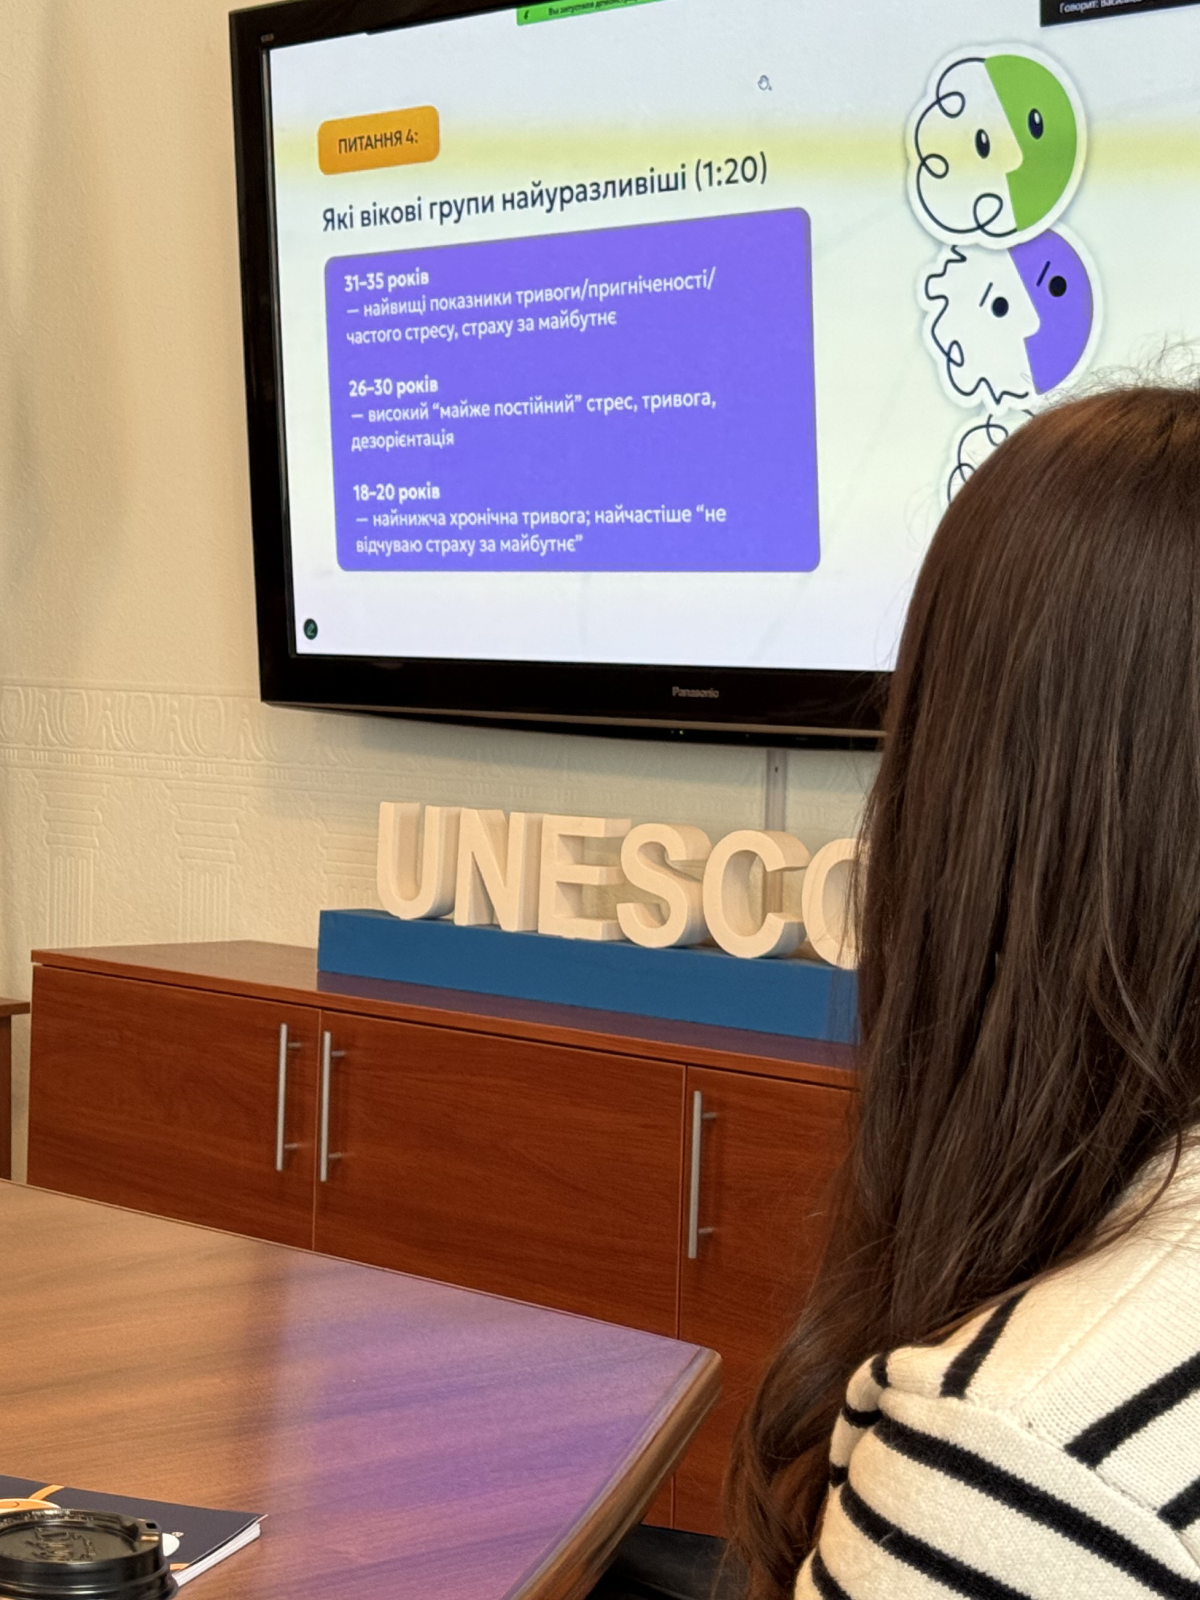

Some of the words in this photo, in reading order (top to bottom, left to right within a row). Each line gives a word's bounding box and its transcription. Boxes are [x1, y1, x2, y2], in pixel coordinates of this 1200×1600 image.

[338, 130, 403, 154] ПИТАННЯ
[405, 128, 419, 145] 4:
[322, 204, 354, 232] Які
[360, 196, 423, 227] вікові
[429, 194, 495, 226] групи
[502, 163, 686, 213] найуразливіші
[695, 151, 767, 192] (1:20)
[363, 295, 426, 317] найвищі
[430, 291, 512, 312] показники
[515, 266, 716, 308] тривоги/пригніченості/
[388, 267, 430, 293] років
[346, 328, 402, 345] частого
[405, 323, 459, 344] стресу,
[462, 319, 514, 340] страху
[517, 317, 534, 332] за
[539, 308, 618, 332] майбутнє
[396, 374, 439, 399] років
[368, 402, 429, 422] високий
[586, 396, 638, 416] стрес,
[642, 391, 717, 414] тривога,
[351, 428, 455, 452] дезорієнтація
[398, 481, 441, 504] років
[372, 508, 446, 527] найнижча
[450, 507, 518, 530] хронічна
[522, 509, 591, 529] тривога;
[595, 504, 692, 524] найчастіше
[356, 535, 423, 557] відчуваю
[425, 538, 476, 558] страху
[479, 539, 496, 553] за
